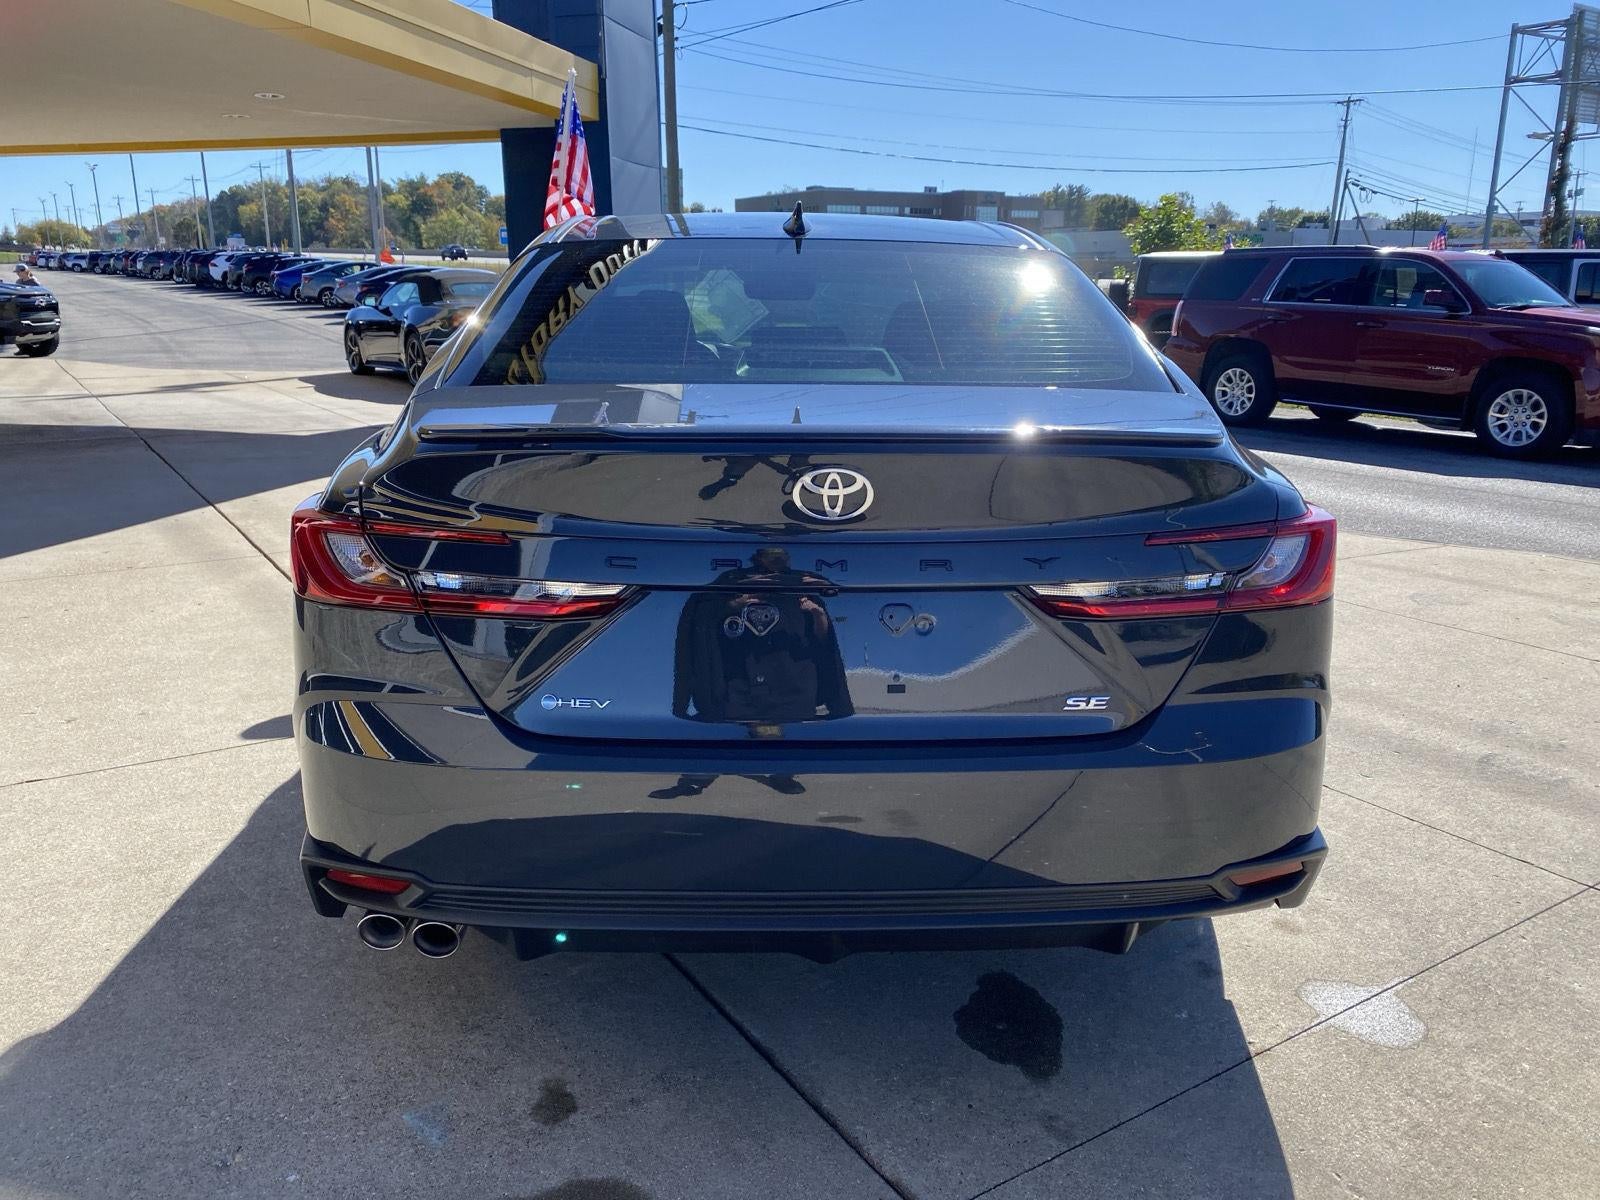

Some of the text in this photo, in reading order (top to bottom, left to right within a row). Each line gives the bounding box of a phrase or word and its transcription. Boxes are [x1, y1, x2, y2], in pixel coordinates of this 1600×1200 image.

[604, 556, 1061, 572] CAMRY
[557, 698, 613, 709] HEV
[1063, 696, 1110, 710] SE
